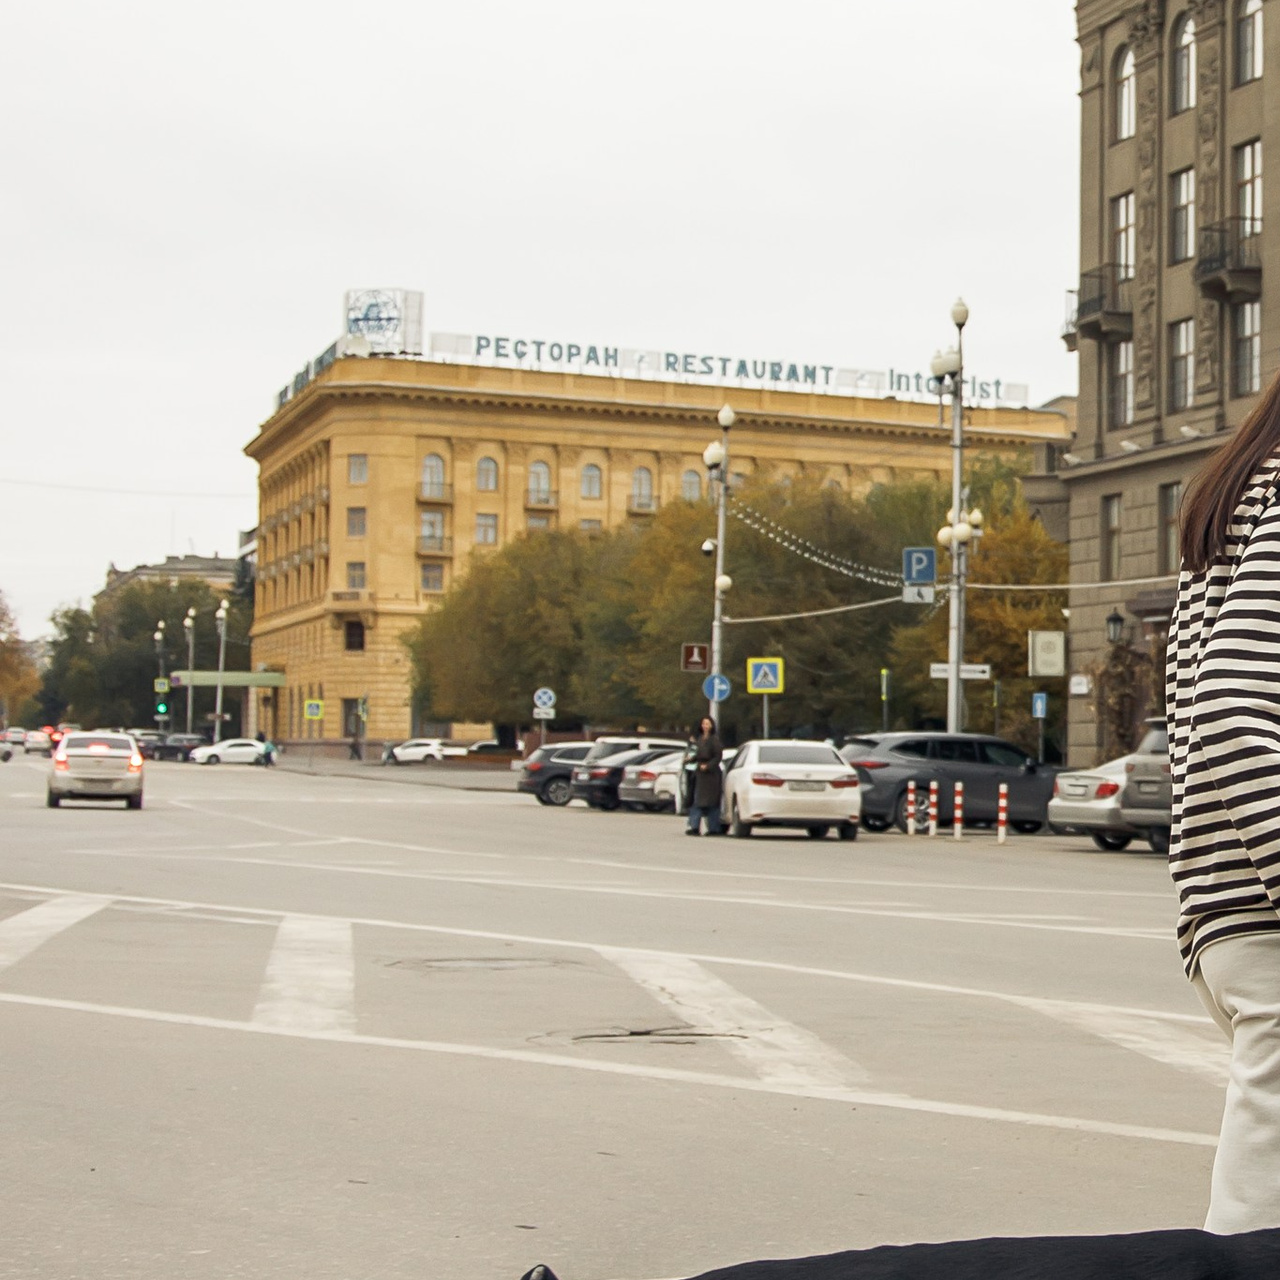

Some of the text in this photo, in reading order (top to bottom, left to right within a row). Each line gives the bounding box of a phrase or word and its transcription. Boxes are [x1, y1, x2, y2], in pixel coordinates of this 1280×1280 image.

[475, 335, 618, 368] РЕСТОРАН
[664, 352, 834, 386] RESTAURANT
[888, 368, 1003, 400] Intoist
[911, 552, 929, 579] P
